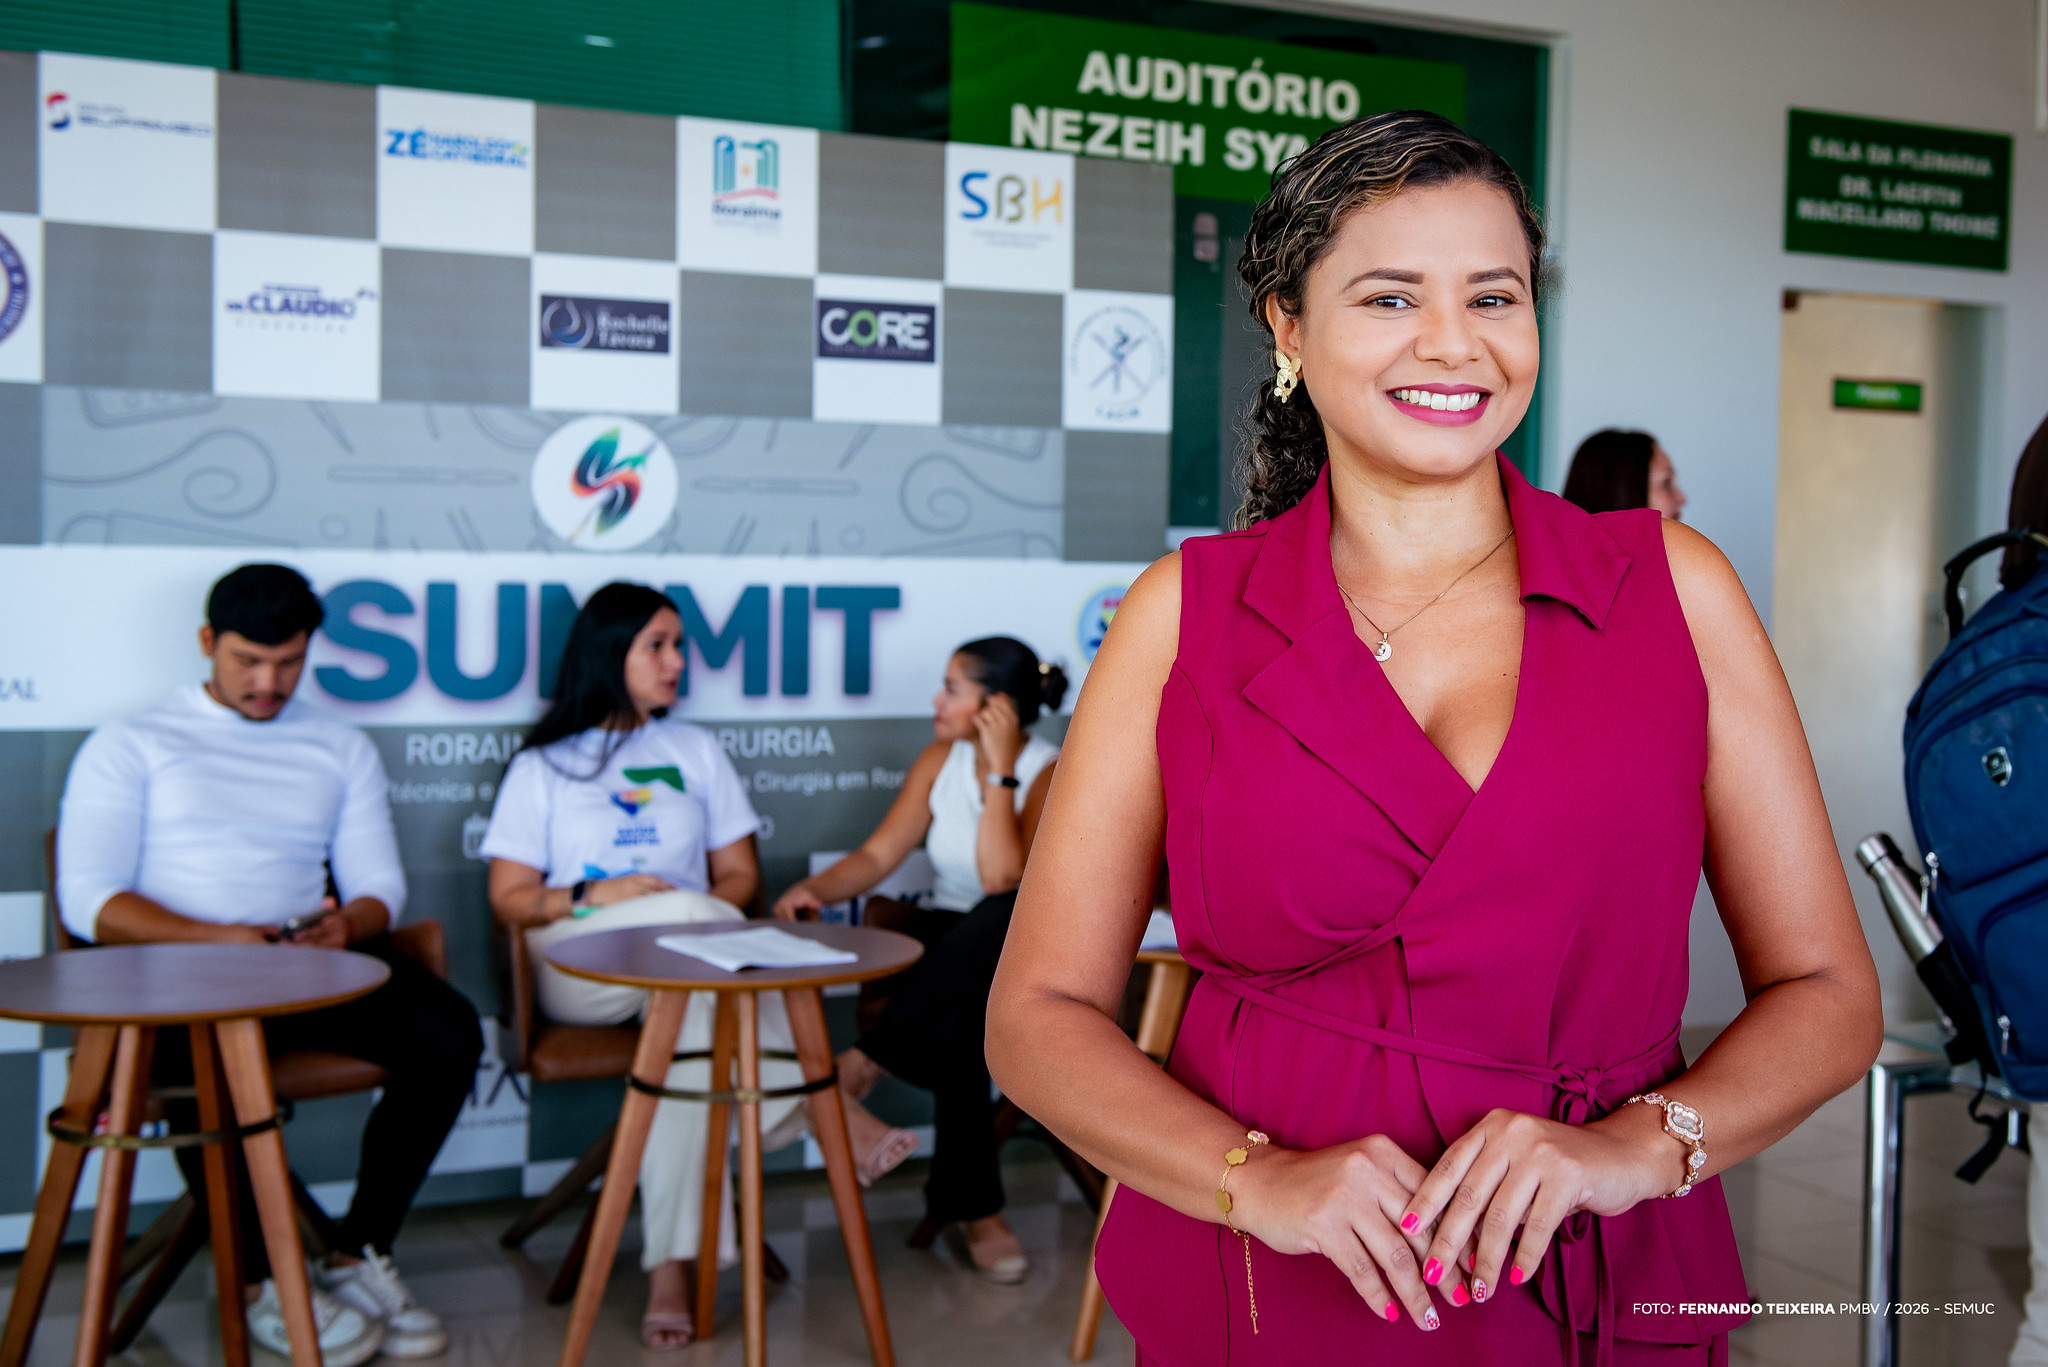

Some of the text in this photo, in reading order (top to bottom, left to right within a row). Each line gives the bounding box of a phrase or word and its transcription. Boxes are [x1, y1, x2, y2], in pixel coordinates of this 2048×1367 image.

[1076, 50, 1361, 122] AUDITÓRIO
[386, 125, 428, 159] ZÉ
[1010, 103, 1310, 174] NEZEIH SYA
[1809, 137, 1861, 161] SALA
[1867, 144, 1893, 166] DA
[959, 171, 1064, 225] SBH
[1840, 175, 1874, 198] DR.
[820, 307, 931, 351] CORE
[406, 725, 836, 767] RORAI RURGIA
[753, 768, 833, 796] Cirurgia
[871, 766, 907, 790] Ror
